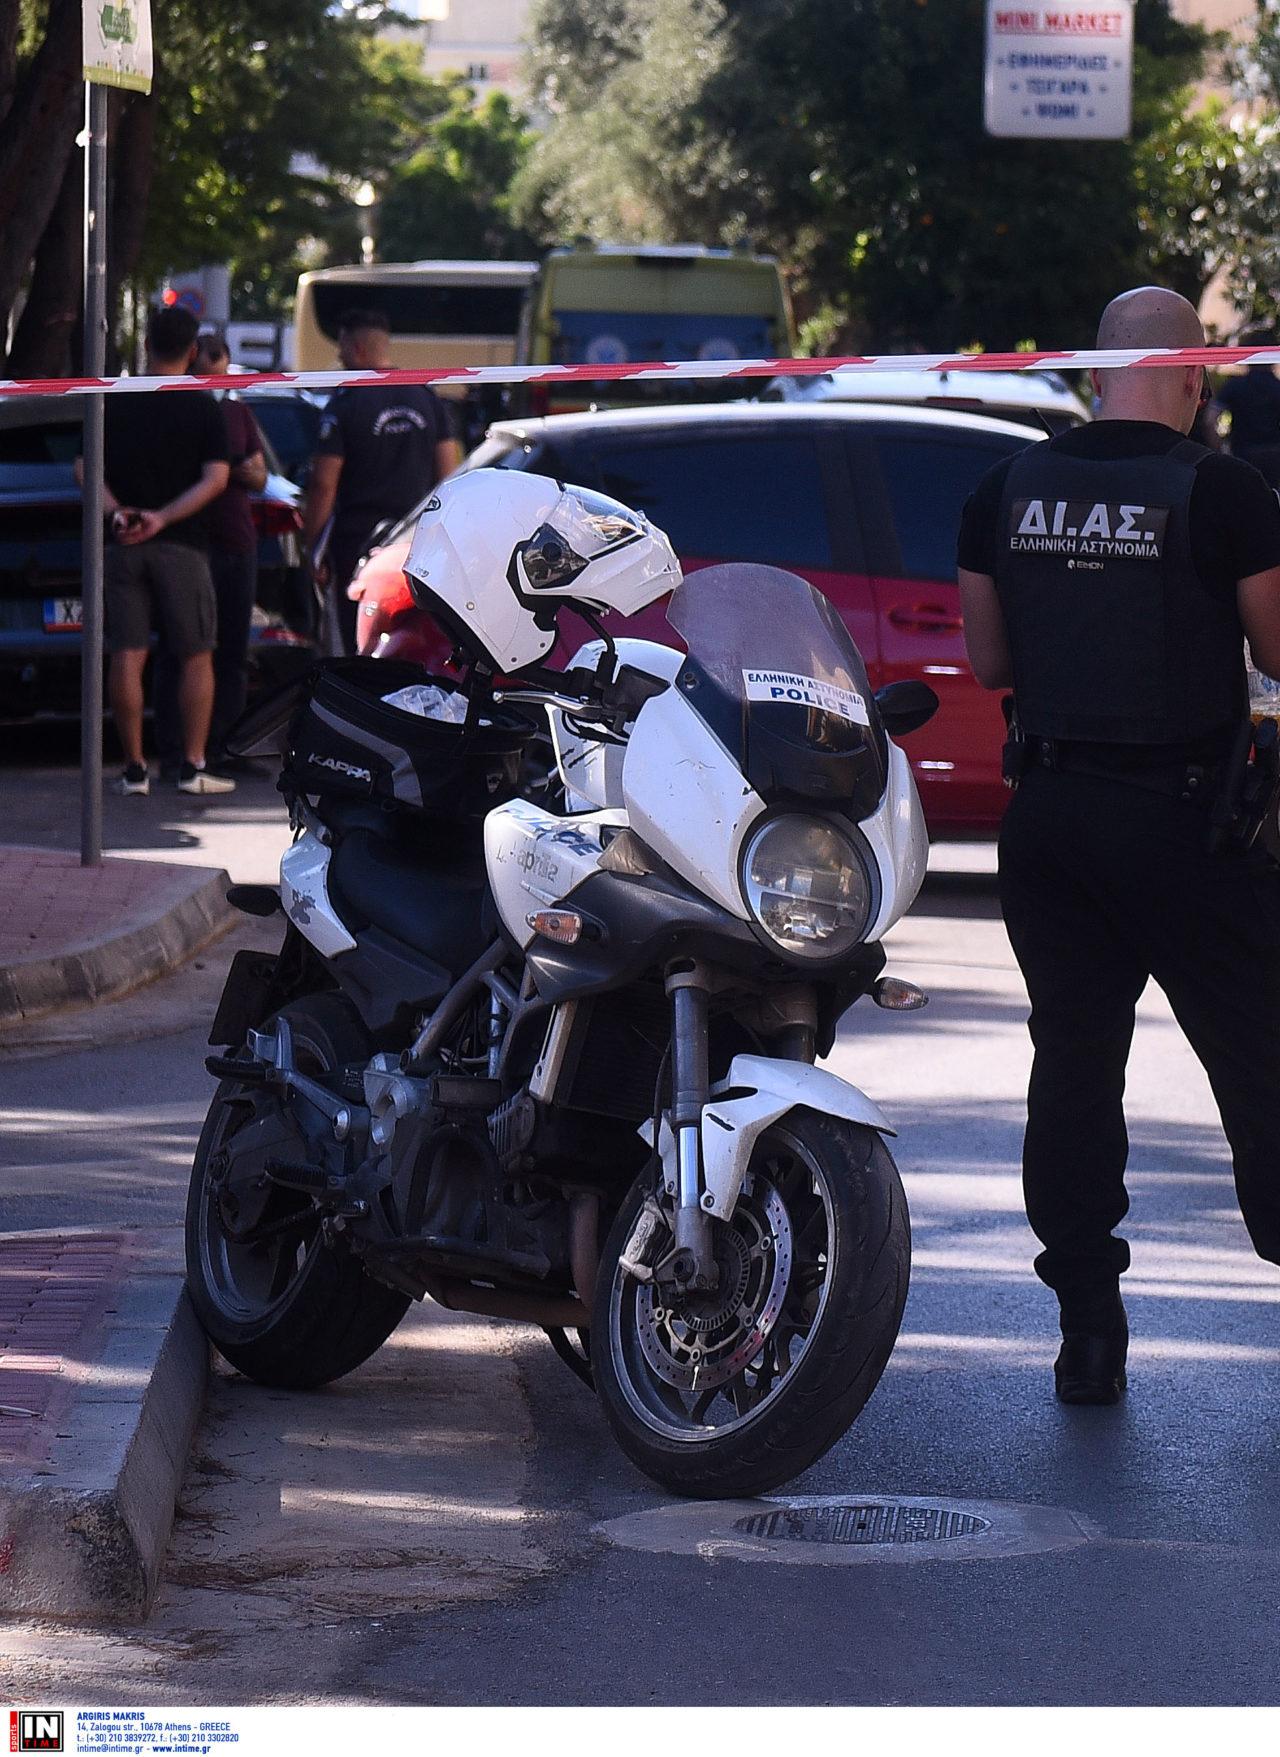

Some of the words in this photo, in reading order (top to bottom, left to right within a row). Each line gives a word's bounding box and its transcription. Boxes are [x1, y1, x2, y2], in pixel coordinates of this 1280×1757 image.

[996, 12, 1037, 31] MINI
[1045, 12, 1121, 33] MARKET
[1017, 500, 1155, 541] ΔΙ.ΑΣ.
[1010, 537, 1077, 553] ΕΛΛΗΝΙΚΗ
[1079, 541, 1160, 558] ΑΣΤΥΝΟΜΙΑ
[748, 673, 805, 687] ΕΛΛΗΝΙΚΗ
[770, 687, 850, 716] POLICE
[308, 753, 371, 782] KAPPA
